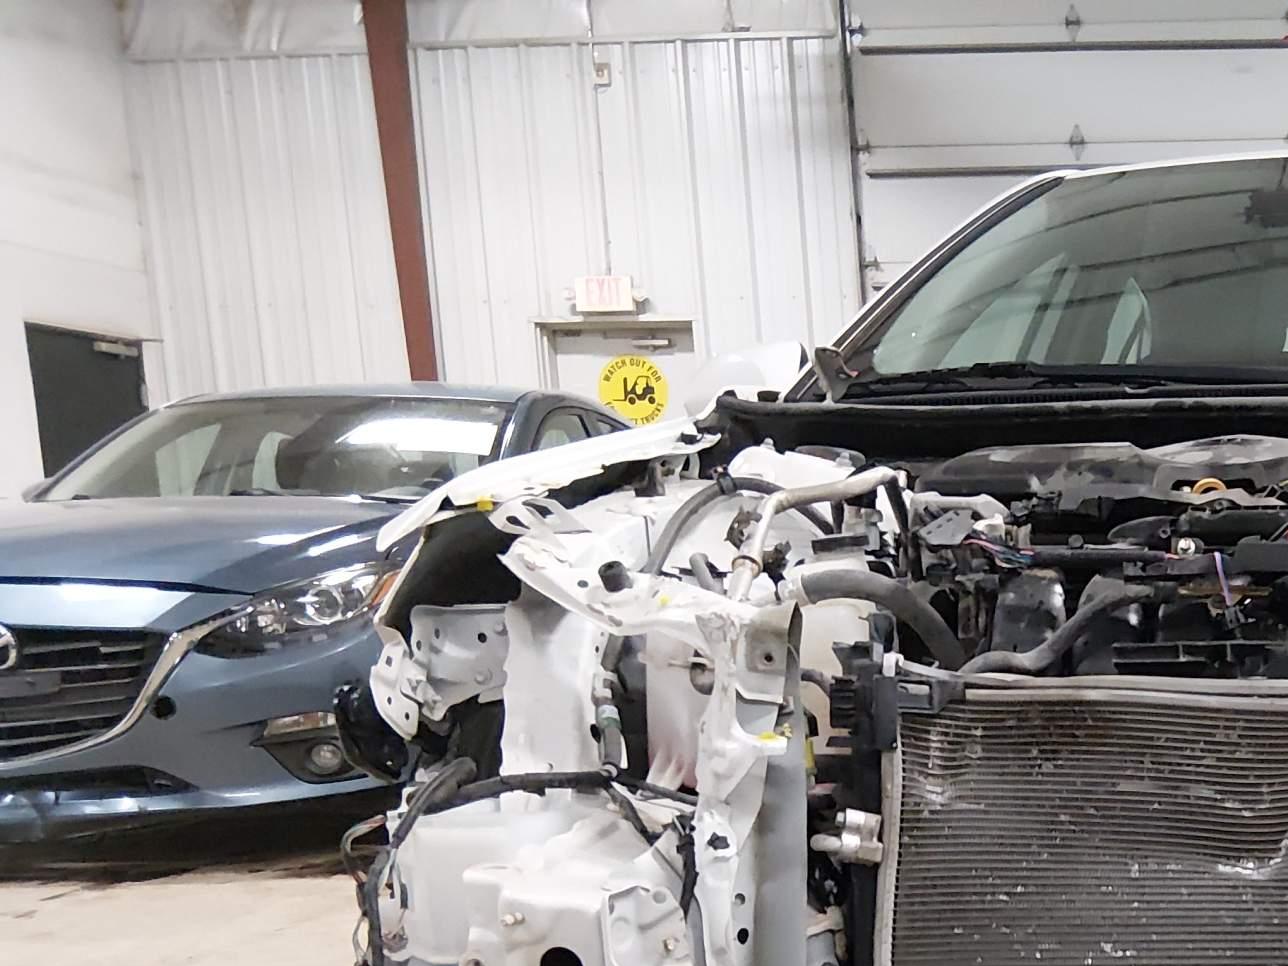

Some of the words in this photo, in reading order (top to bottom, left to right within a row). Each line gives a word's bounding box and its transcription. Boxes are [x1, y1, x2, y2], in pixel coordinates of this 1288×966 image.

[585, 278, 622, 306] EXIT
[603, 359, 627, 382] WATCH
[629, 358, 646, 368] OUT
[647, 366, 662, 383] FOR
[640, 402, 665, 425] TRUCKS
